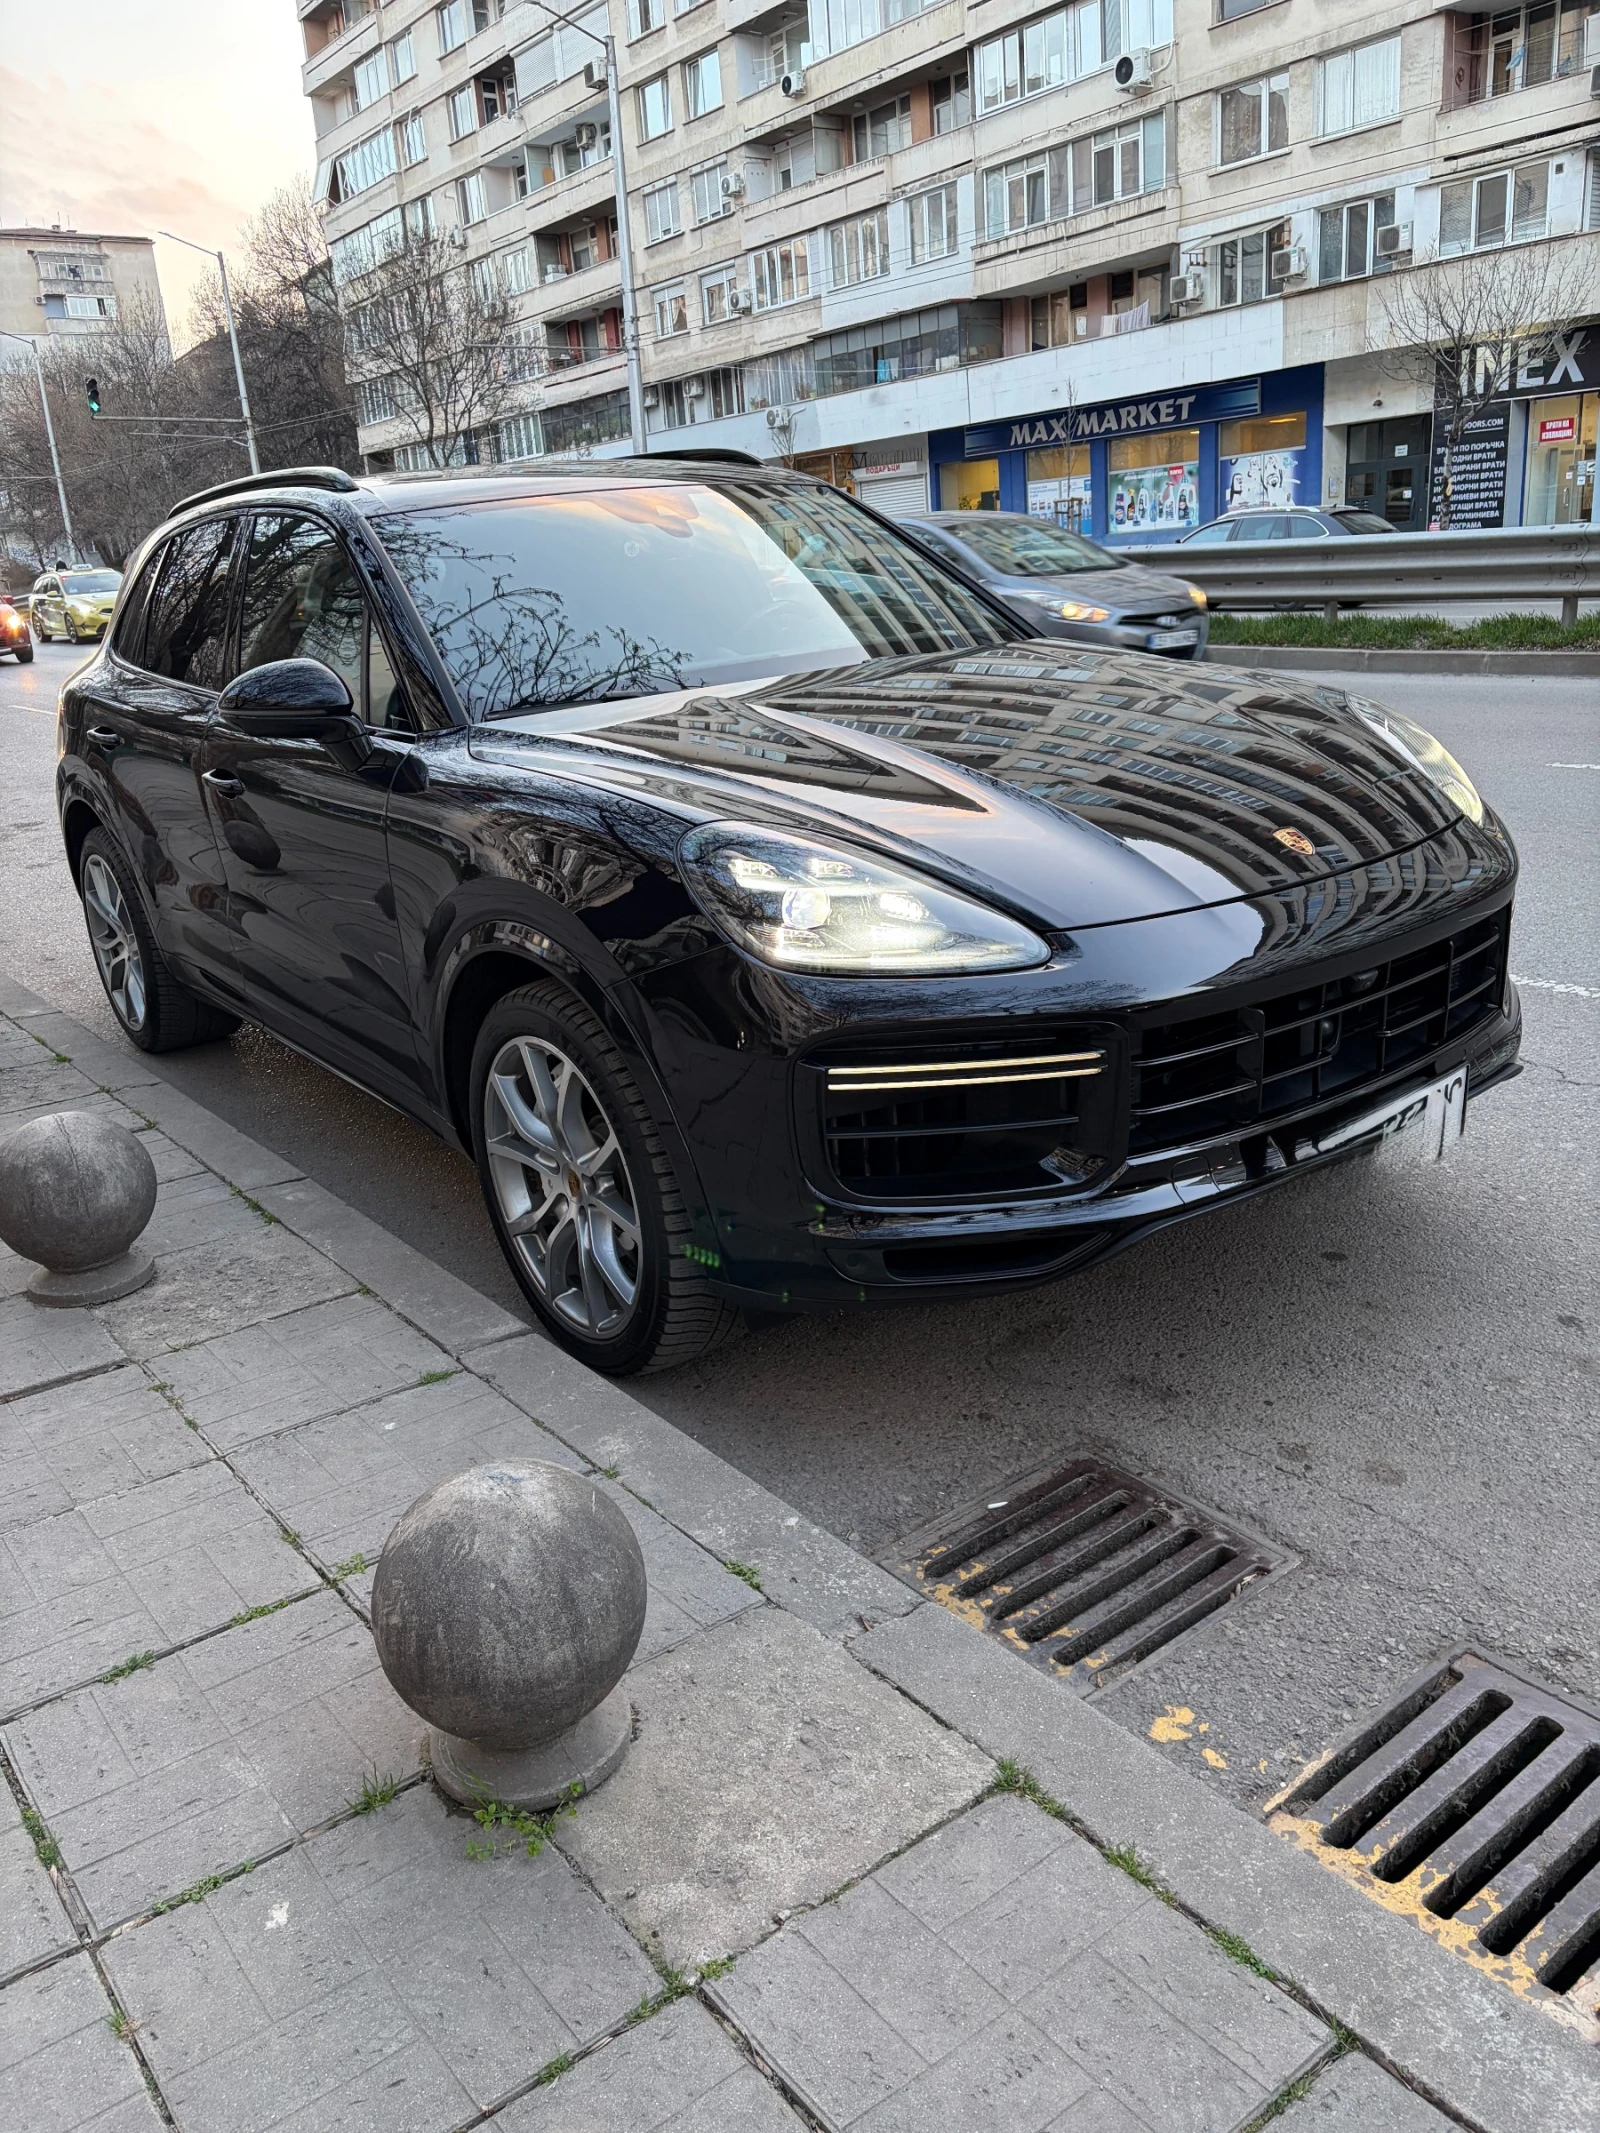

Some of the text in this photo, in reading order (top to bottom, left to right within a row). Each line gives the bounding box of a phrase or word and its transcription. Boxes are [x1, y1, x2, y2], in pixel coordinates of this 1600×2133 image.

[1459, 331, 1587, 397] INEX
[1010, 395, 1196, 446] MAX MARKET
[1460, 444, 1470, 452] ПО
[1470, 440, 1505, 451] ПОРЪЧКА
[1473, 451, 1496, 461] ВРАТИ
[865, 463, 901, 475] ПОДАРЪЦИ
[1169, 468, 1183, 476] sano
[1434, 460, 1505, 475] БЛДИРАНИ ВРАТИ
[1434, 470, 1504, 484] СТДАРТНИ ВРАТИ
[1433, 480, 1503, 494] ИНРИОРНИ ВРАТИ
[1480, 490, 1503, 500] ВРАТИ
[1474, 500, 1498, 510] ВРАТИ
[1451, 510, 1500, 521] АЛУМИНИЕВА
[1449, 521, 1482, 530] ДОГРАМА
